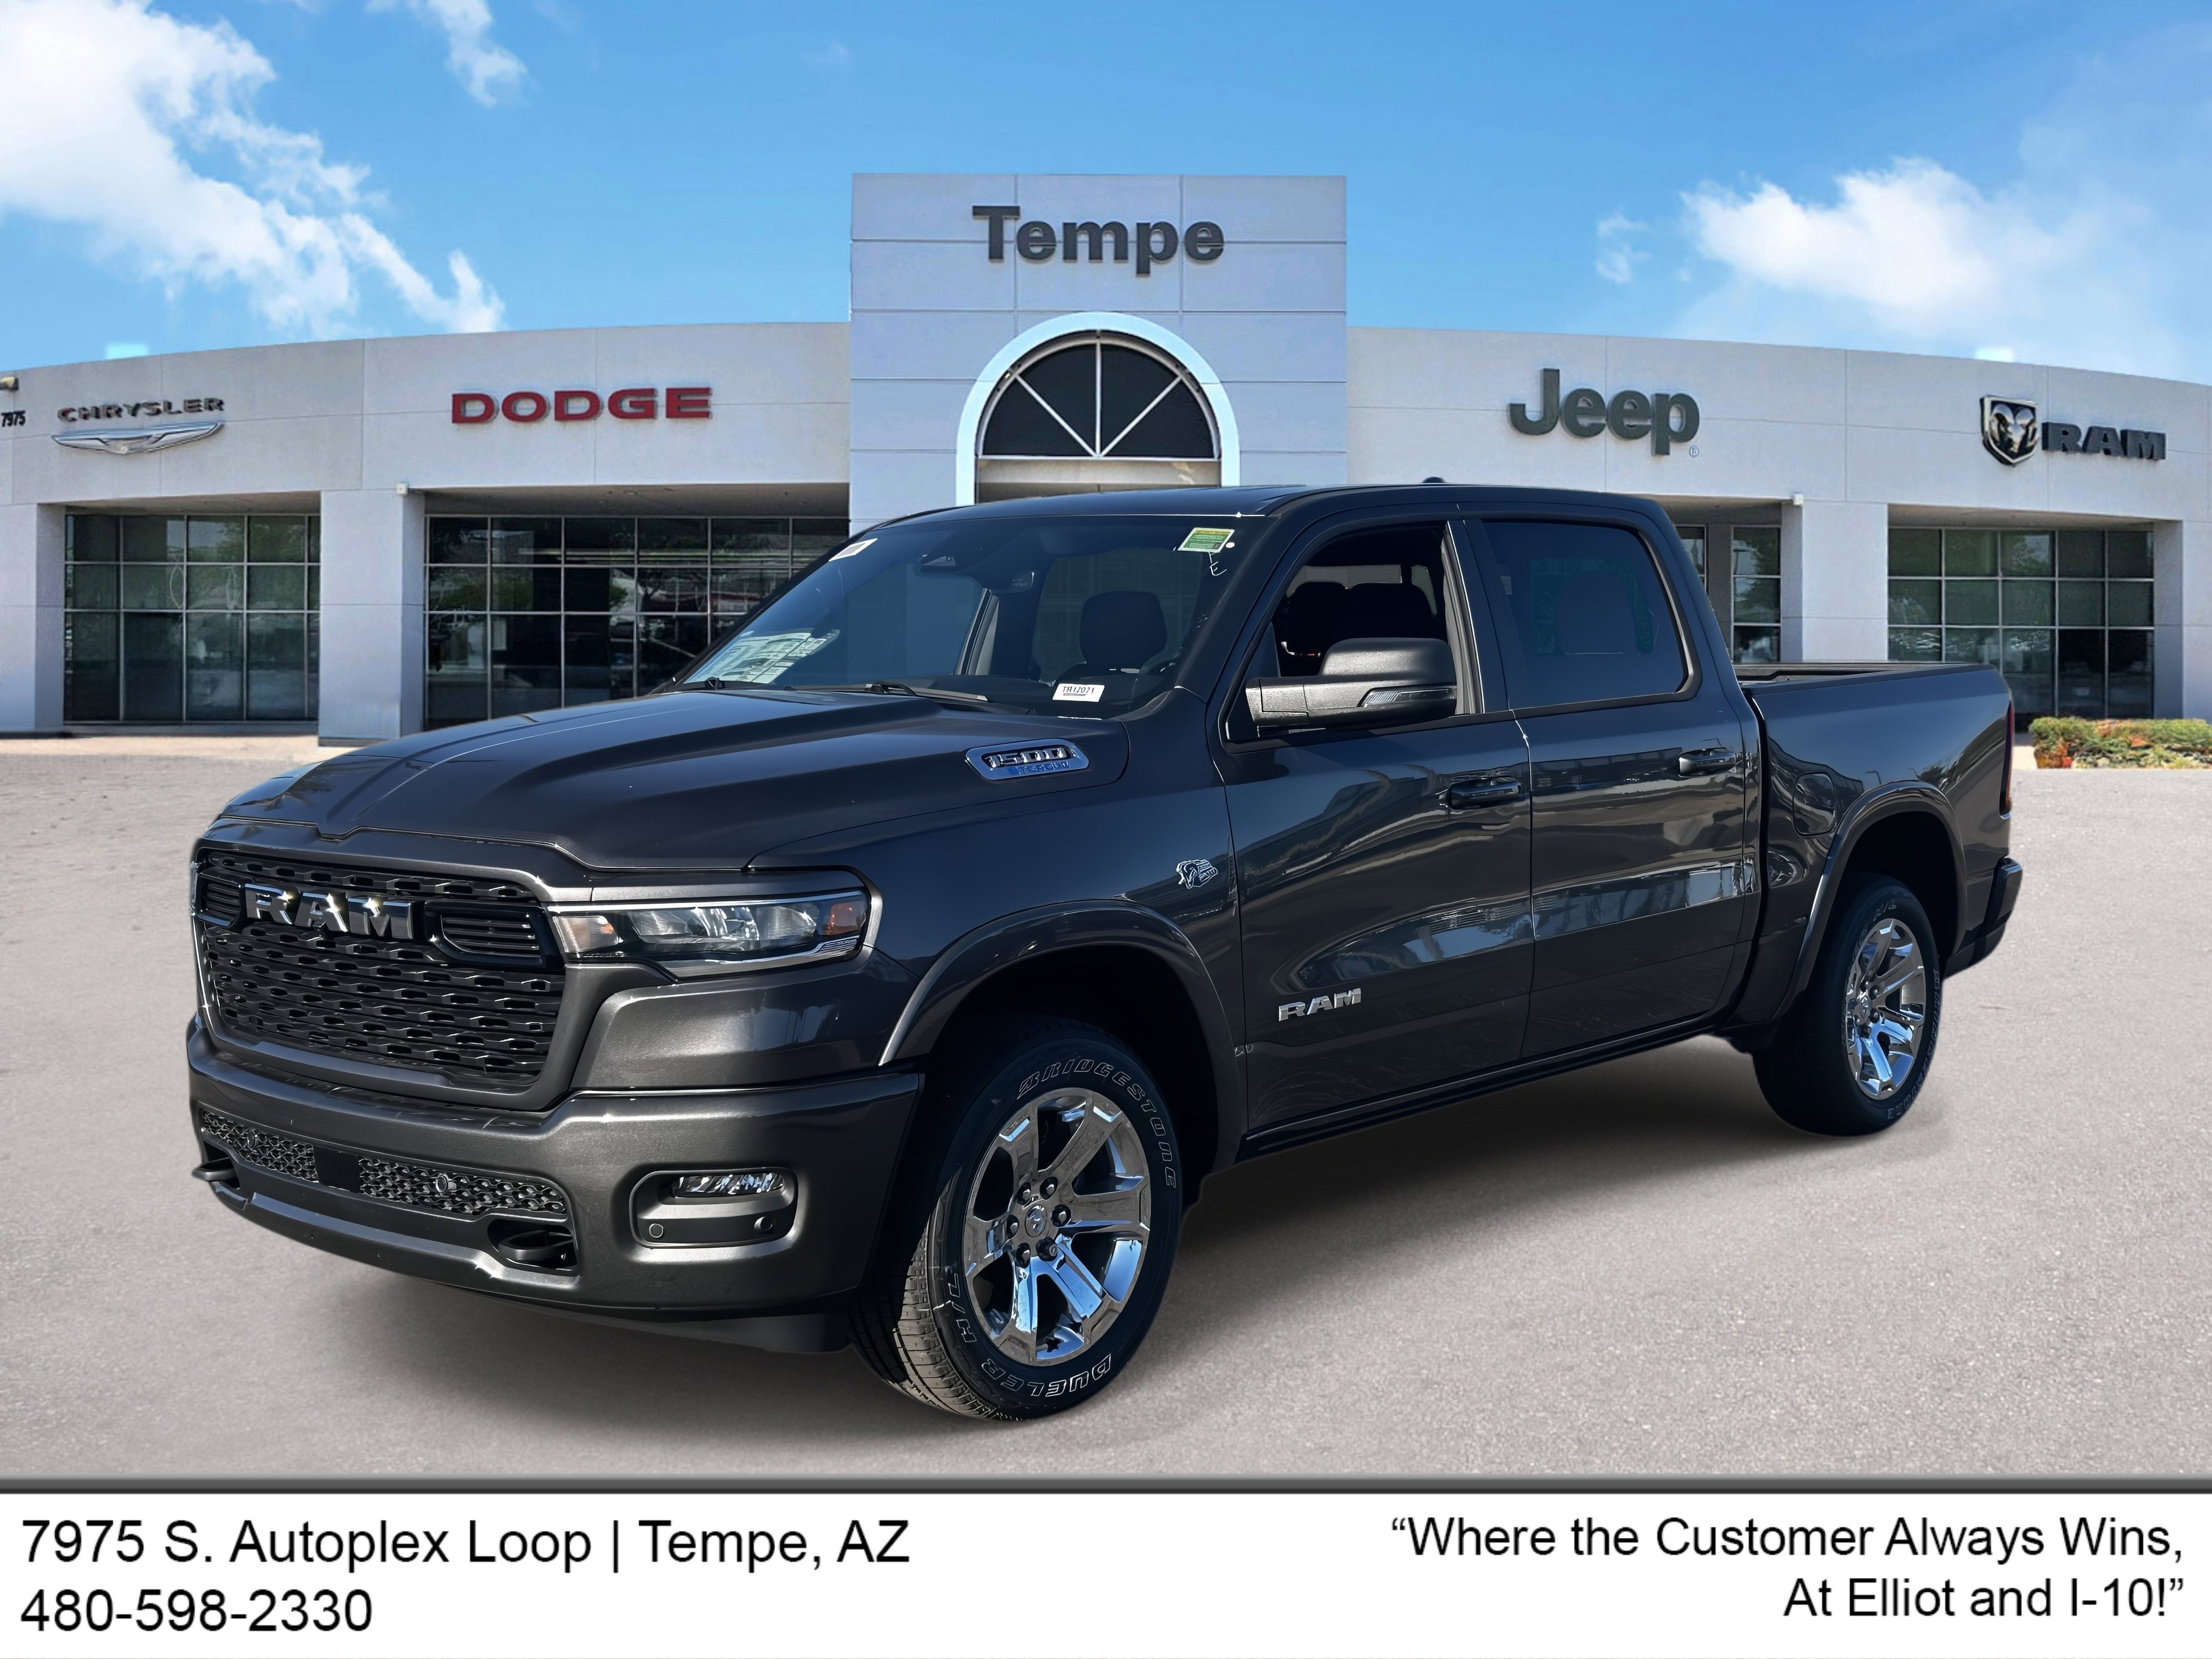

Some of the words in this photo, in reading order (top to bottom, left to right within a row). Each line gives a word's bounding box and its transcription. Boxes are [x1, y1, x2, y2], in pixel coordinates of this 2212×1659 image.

[972, 205, 1226, 278] Tempe
[1, 410, 26, 427] 7975
[57, 397, 225, 422] CHRYSLER
[451, 387, 713, 424] DODGE
[1507, 367, 1700, 456] Jeep
[2041, 421, 2166, 460] RAM
[984, 747, 1068, 768] 1500
[244, 883, 414, 940] RAM
[1278, 987, 1362, 1022] RAM
[1016, 1059, 1177, 1188] BRIDGESTONE
[981, 1353, 1112, 1397] DUELER
